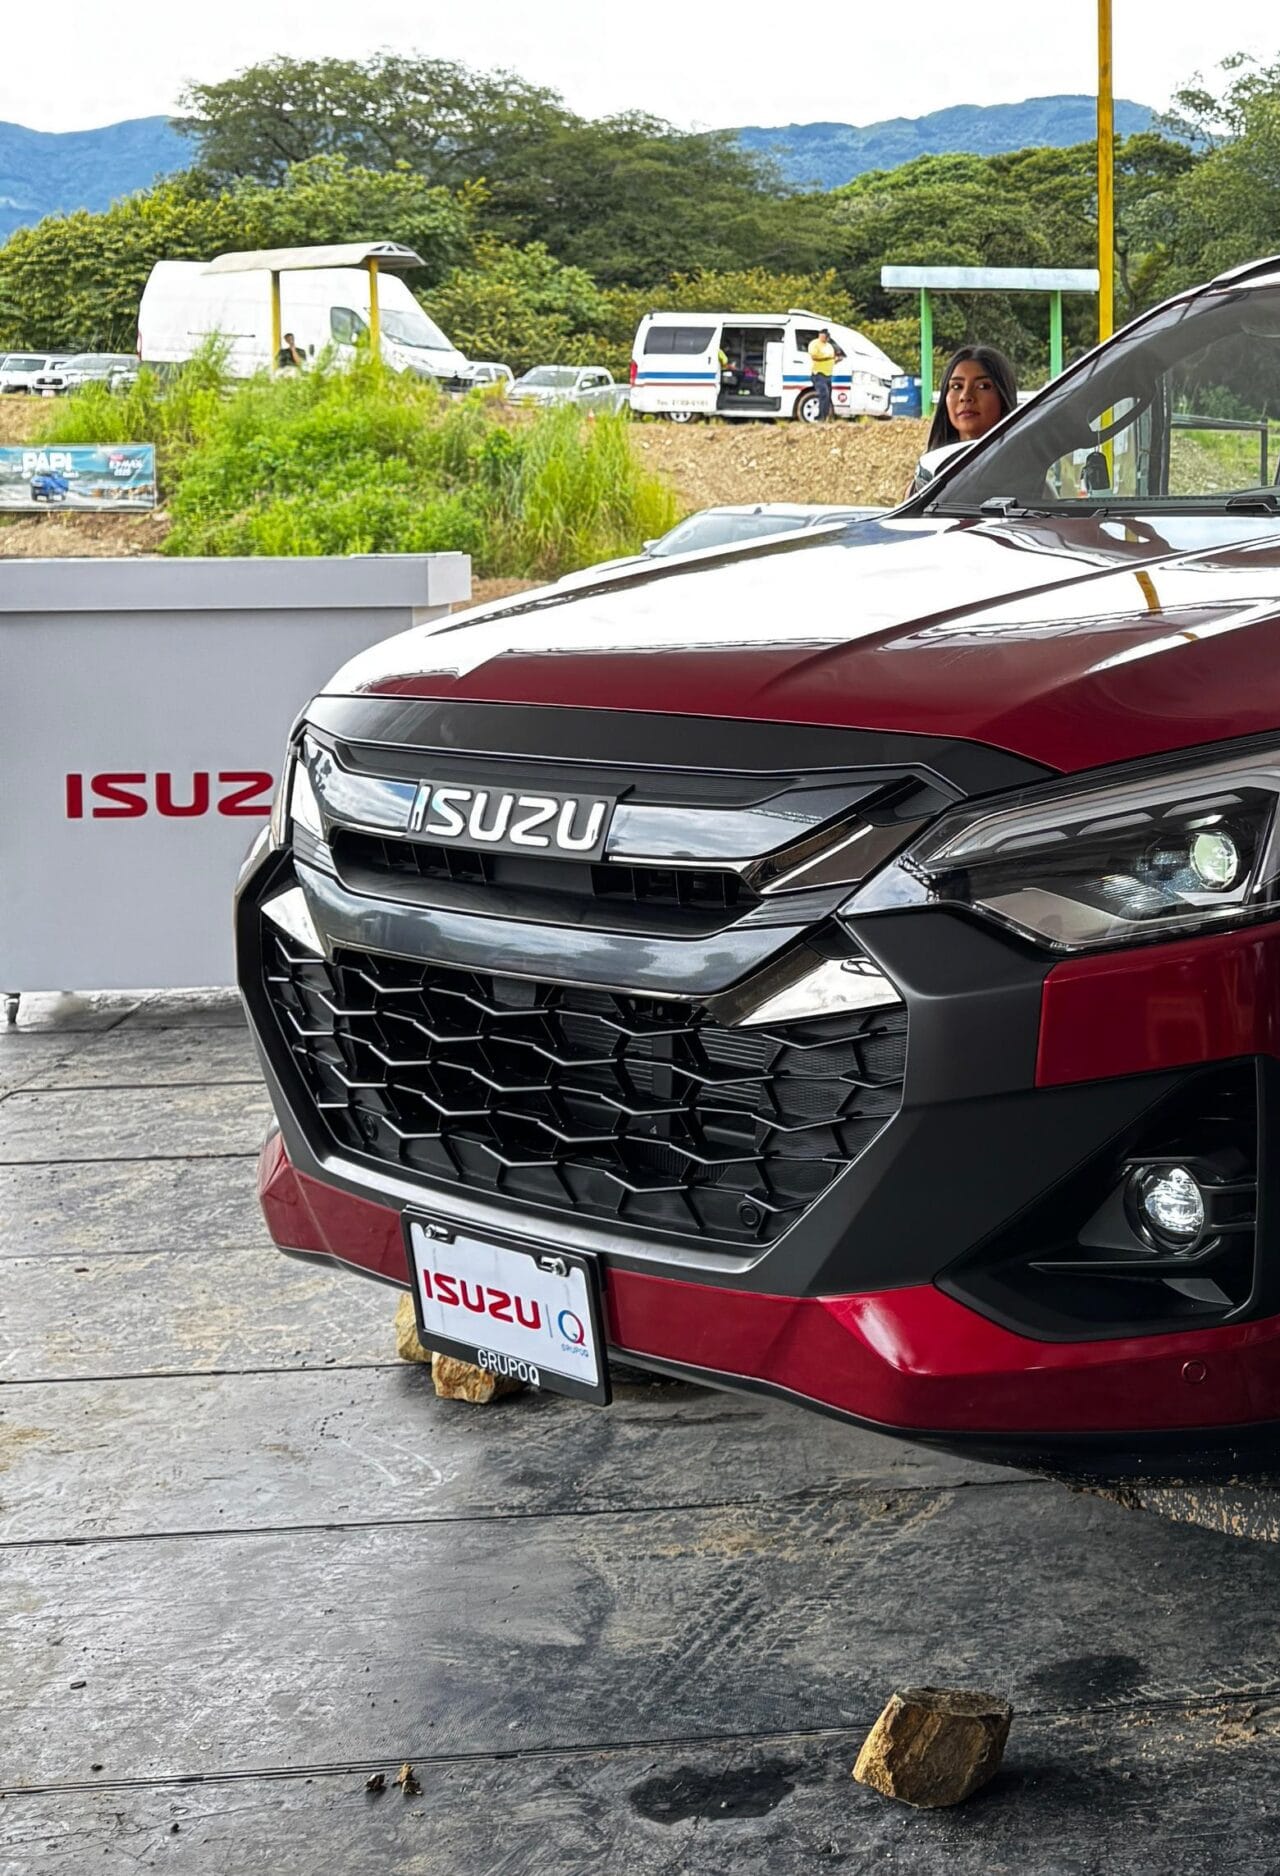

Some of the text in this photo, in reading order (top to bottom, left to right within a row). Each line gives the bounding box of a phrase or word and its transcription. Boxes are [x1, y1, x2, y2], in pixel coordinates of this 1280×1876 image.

[66, 772, 274, 819] ISUZ
[410, 785, 606, 851] ISUZU
[423, 1268, 542, 1330] ISUZU
